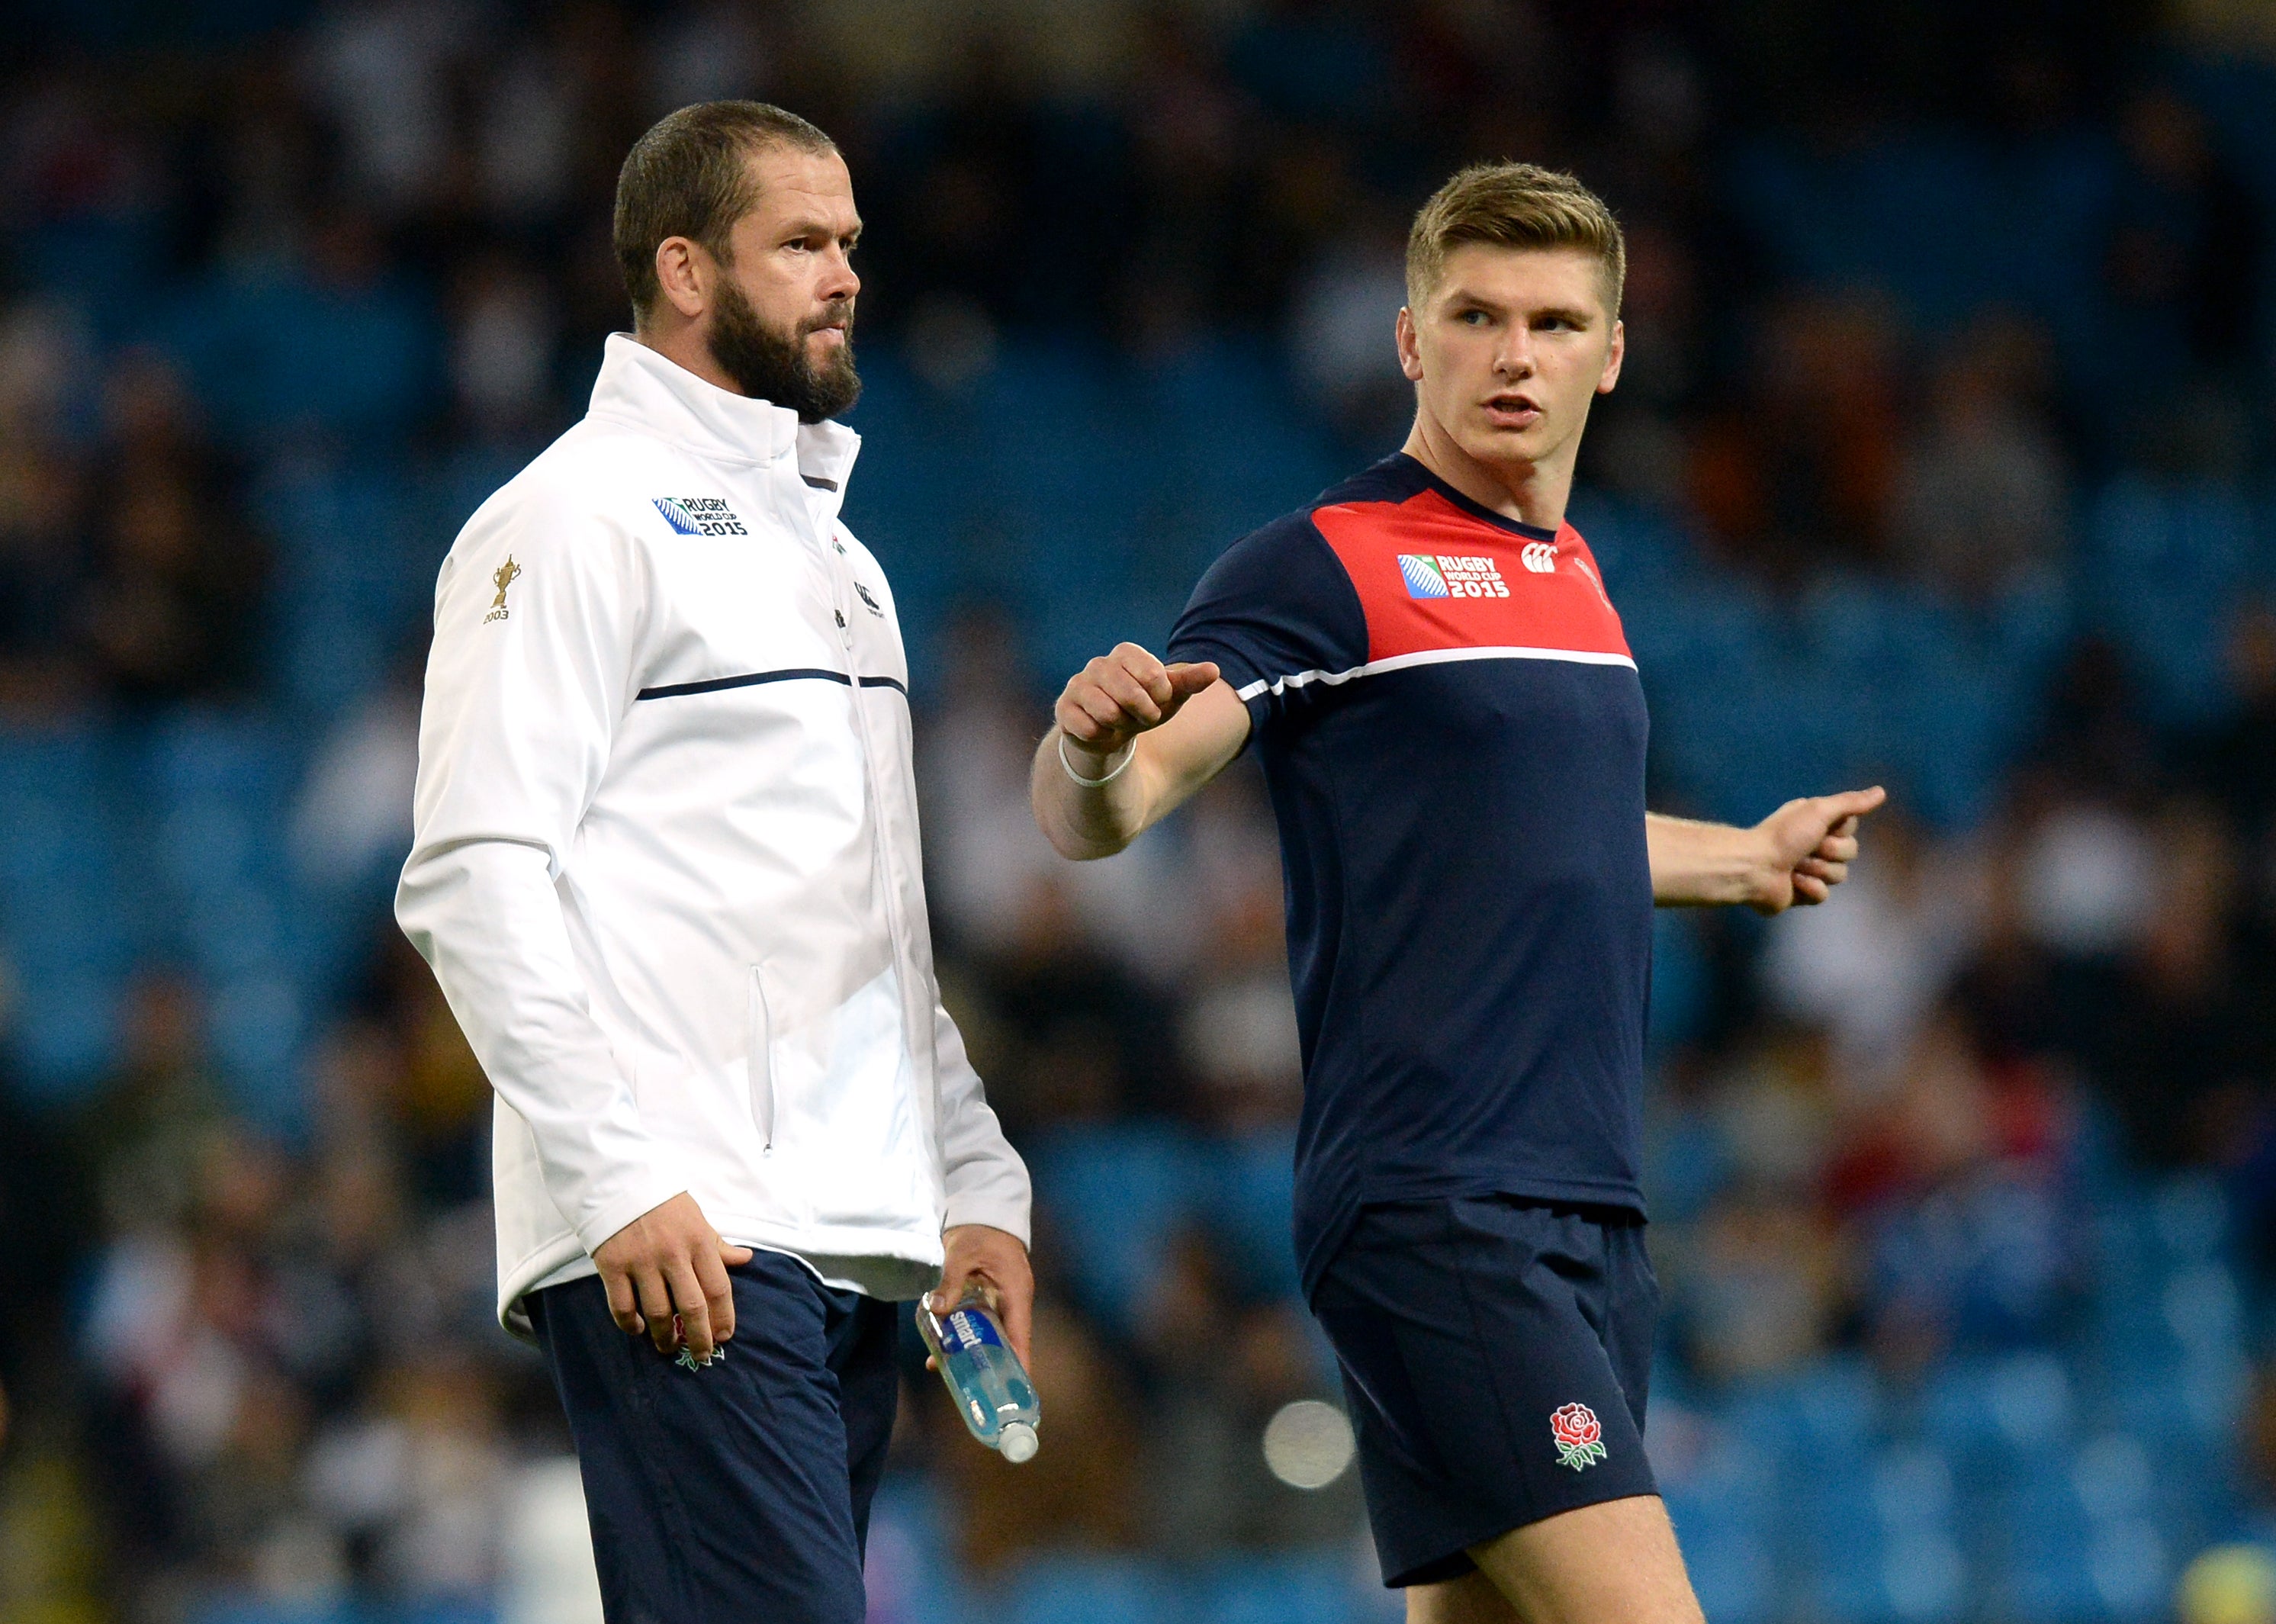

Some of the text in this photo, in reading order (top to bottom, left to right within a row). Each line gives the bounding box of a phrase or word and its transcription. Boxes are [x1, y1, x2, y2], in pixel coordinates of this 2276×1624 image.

[682, 498, 729, 512] RUGBY
[699, 522, 748, 536] 2015
[1435, 555, 1496, 572] RUGBY
[1443, 571, 1502, 580] WORLD CUP
[1448, 580, 1510, 598] 2015
[950, 1310, 982, 1349] smart
